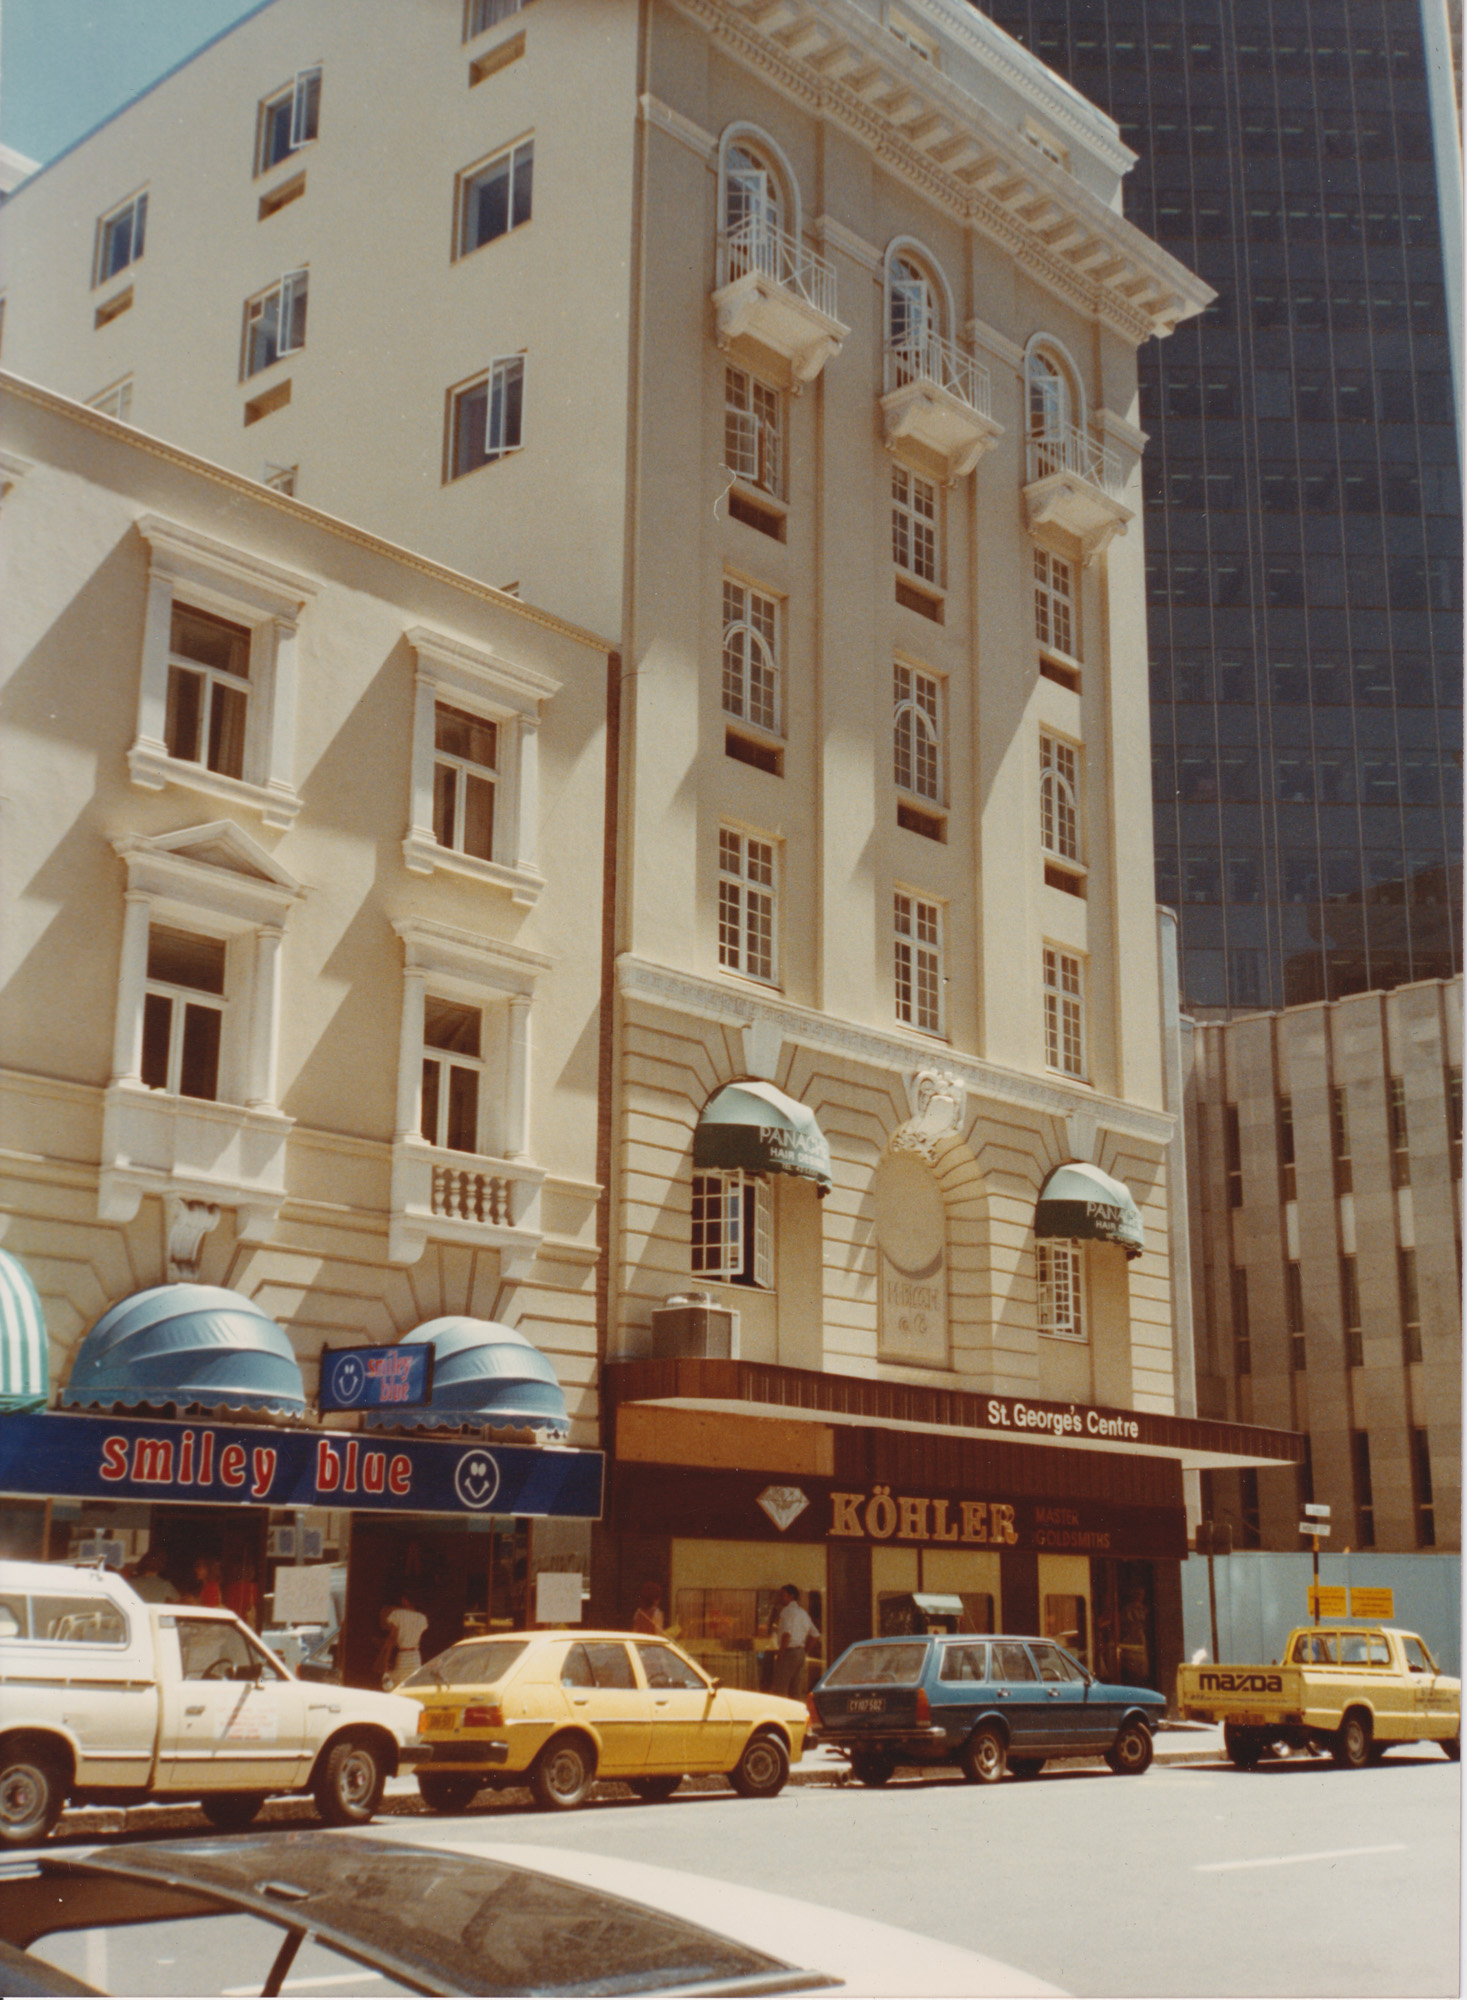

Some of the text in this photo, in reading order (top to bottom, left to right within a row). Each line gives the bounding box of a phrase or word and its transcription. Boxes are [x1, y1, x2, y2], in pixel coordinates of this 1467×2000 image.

[769, 1146, 826, 1169] HAIR DES
[1086, 1201, 1142, 1231] PANAC
[1095, 1220, 1116, 1232] HAIR
[367, 1350, 413, 1383] smiley
[379, 1376, 410, 1402] blue
[1013, 1403, 1082, 1435] George's
[1086, 1411, 1139, 1438] Centre
[100, 1430, 412, 1496] smiley blue
[829, 1485, 1018, 1545] KÖHLER
[1035, 1507, 1079, 1525] MASTER
[1035, 1529, 1110, 1549] GOLDSMITHS
